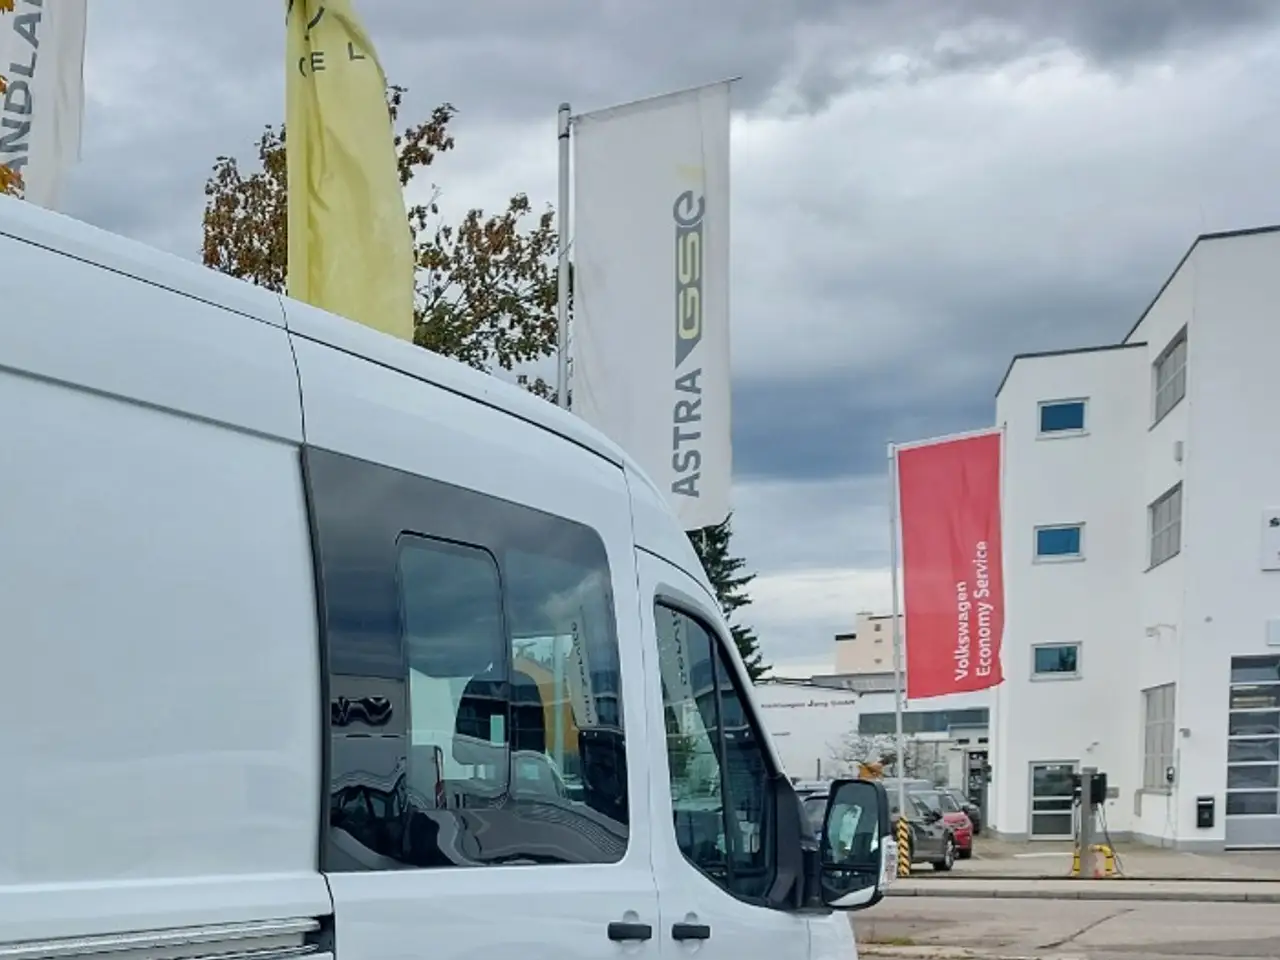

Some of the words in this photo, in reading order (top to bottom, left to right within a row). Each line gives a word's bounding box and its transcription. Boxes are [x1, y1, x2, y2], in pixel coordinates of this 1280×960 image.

[671, 368, 703, 498] ASTRA
[973, 541, 990, 599] Service
[954, 581, 971, 681] Volkswagen
[975, 602, 993, 677] Economy
